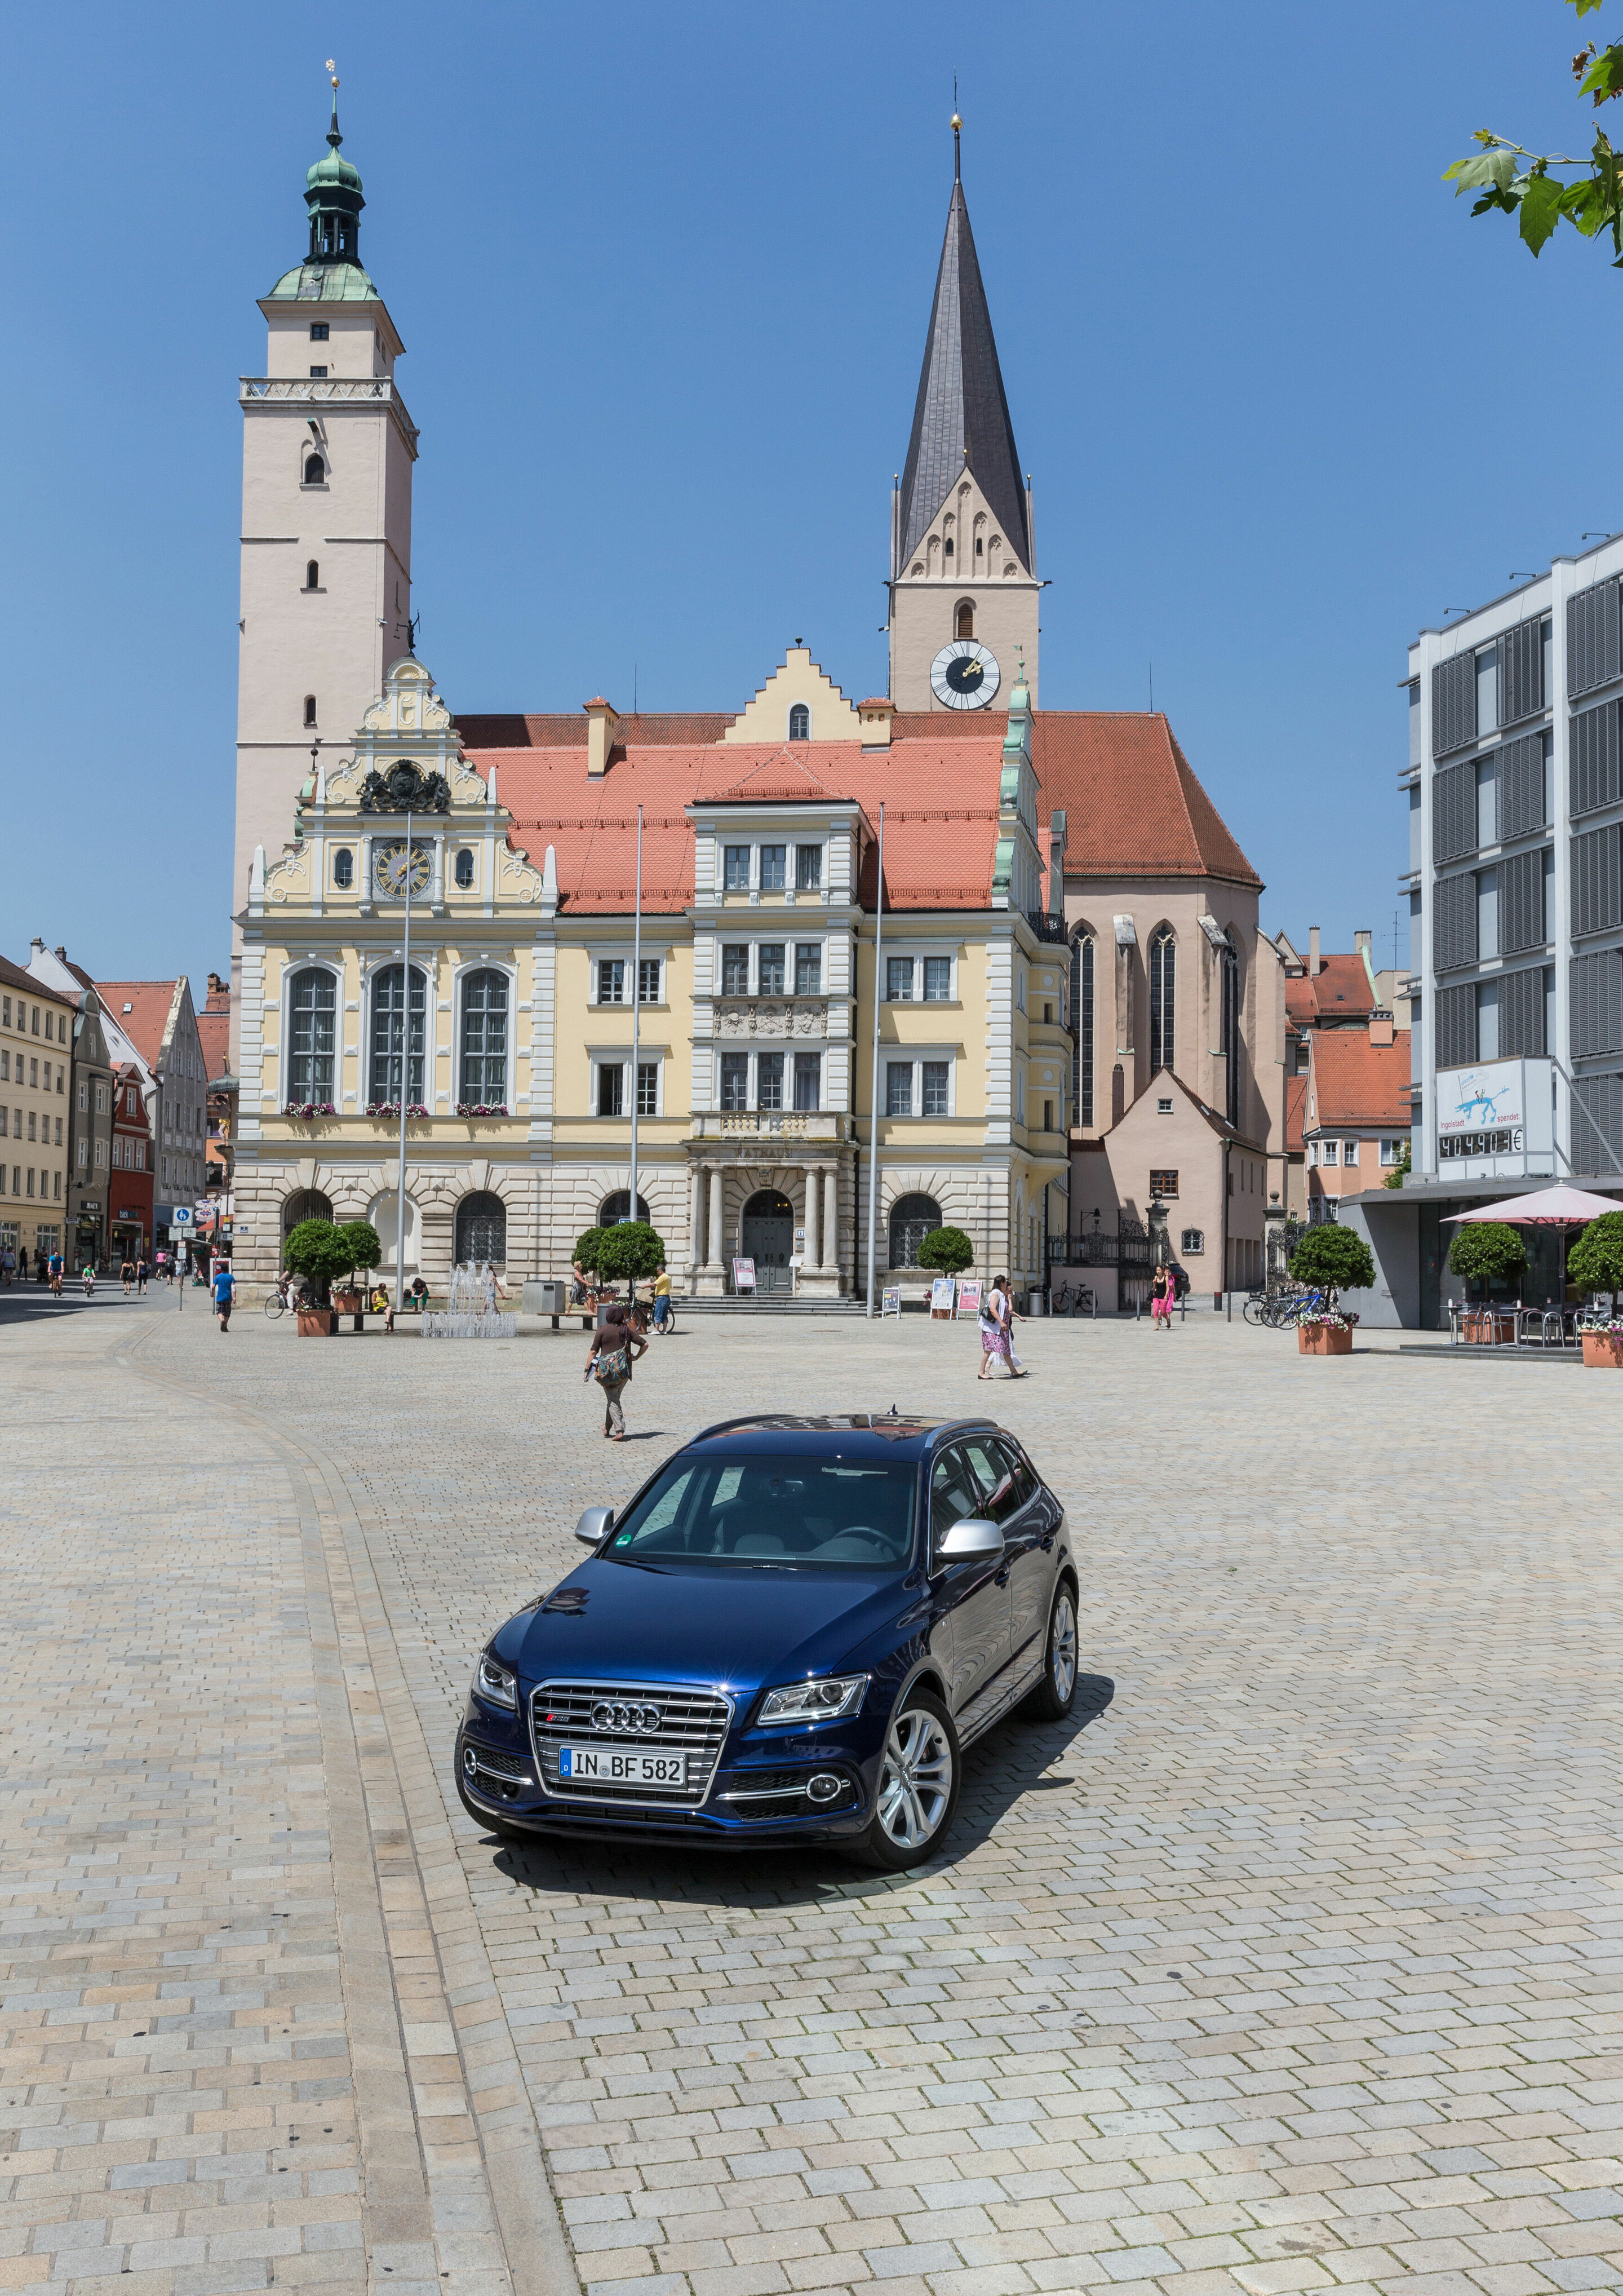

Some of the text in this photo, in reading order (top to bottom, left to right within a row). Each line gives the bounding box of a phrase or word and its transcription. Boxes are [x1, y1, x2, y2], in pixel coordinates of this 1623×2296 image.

[1440, 1113, 1520, 1130] Ingolstadt spendet:
[737, 1149, 791, 1158] RATHAUS
[574, 1753, 680, 1781] IN BF 582
